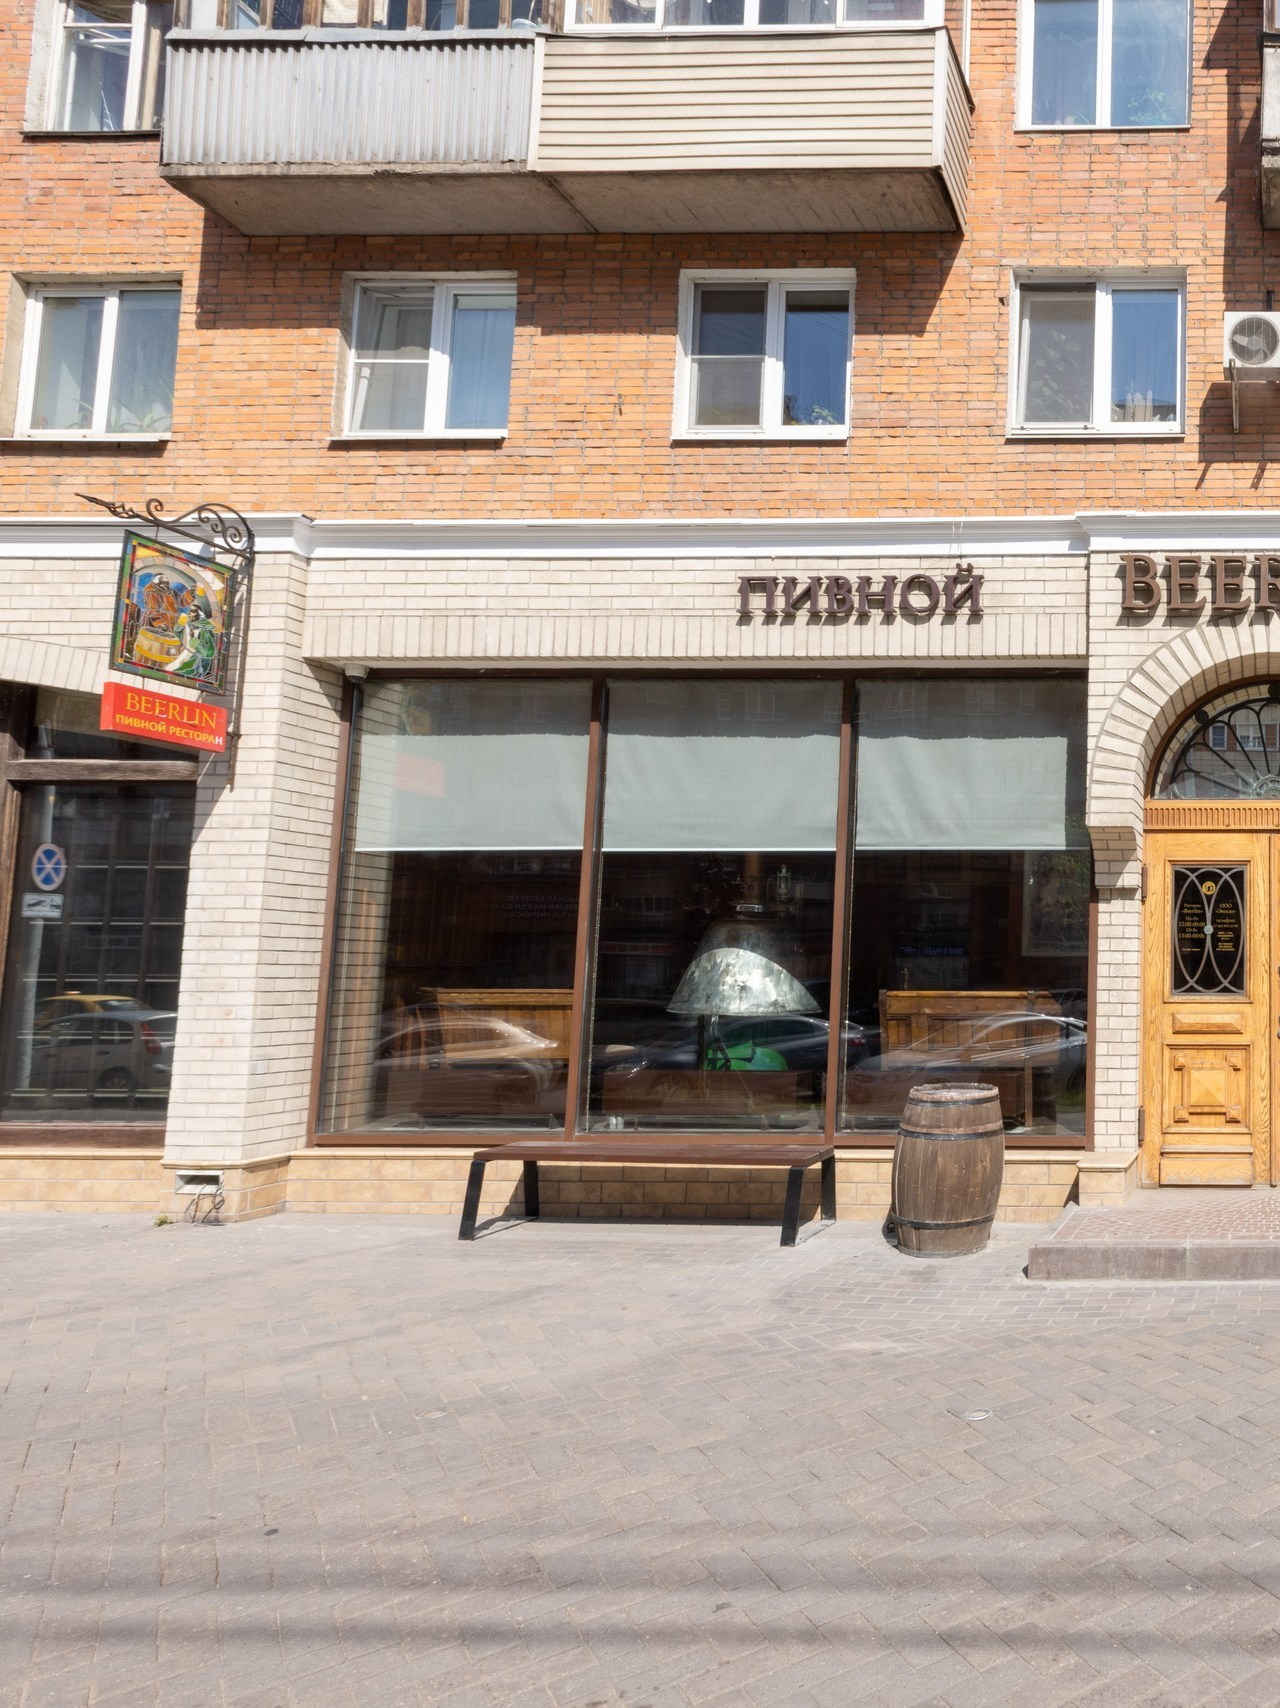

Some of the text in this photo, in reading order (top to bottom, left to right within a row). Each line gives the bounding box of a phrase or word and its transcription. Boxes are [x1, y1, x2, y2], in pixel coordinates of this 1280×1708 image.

[736, 563, 985, 616] ПИВНОЙ
[127, 693, 217, 729] BEERLIN
[116, 714, 223, 745] ПИВНОЙ РЕСТОРАН
